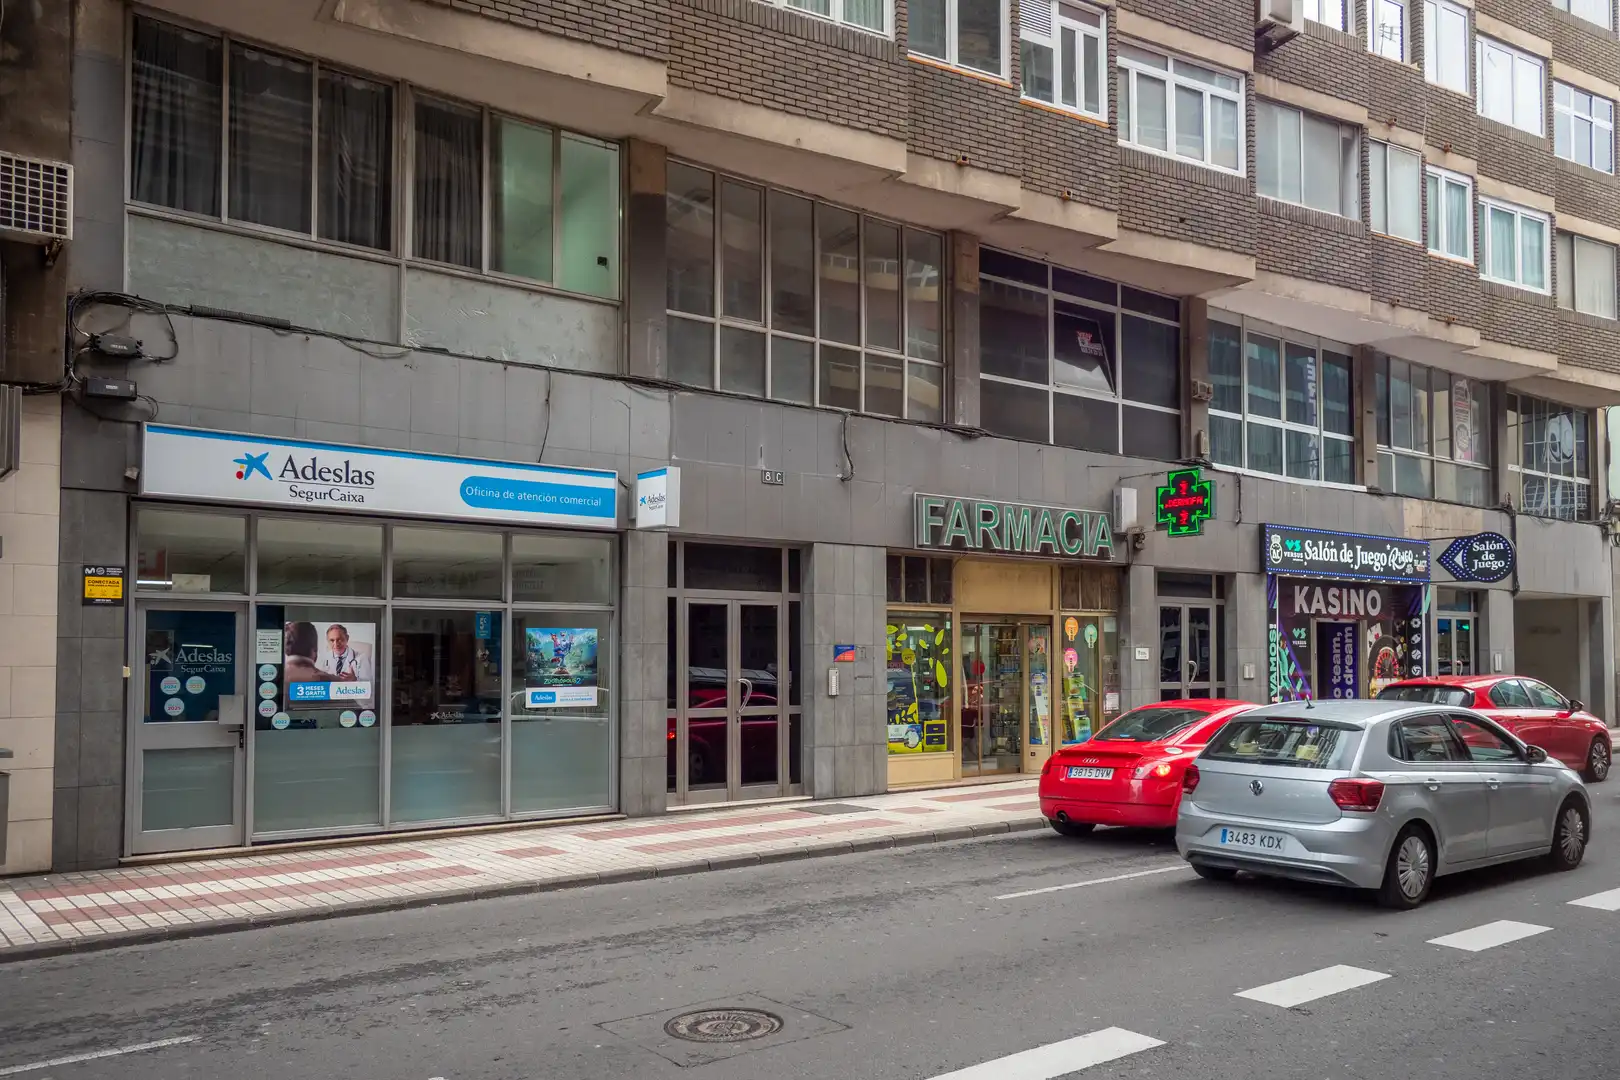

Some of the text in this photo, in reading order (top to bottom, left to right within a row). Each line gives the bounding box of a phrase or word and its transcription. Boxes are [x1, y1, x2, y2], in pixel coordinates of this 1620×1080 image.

[279, 454, 375, 486] Adeslas
[776, 472, 782, 482] C
[289, 484, 365, 503] SegurCaixa
[465, 486, 602, 506] Oficina de atención comercial
[648, 493, 666, 503] Adeslas
[921, 497, 1116, 558] FARMACIA
[1472, 540, 1504, 552] Salón
[1304, 540, 1338, 562] Salón
[1340, 542, 1354, 563] de
[1354, 545, 1388, 572] Juego
[1481, 551, 1495, 560] de
[1471, 559, 1505, 572] Juego
[1294, 585, 1382, 617] KASINO
[175, 647, 233, 663] Adeslas
[1343, 626, 1354, 685] dream
[180, 664, 226, 674] SegurCaixa
[296, 686, 304, 696] 3
[335, 686, 366, 695] Adeslas
[1073, 767, 1112, 778] 3815 DVM
[1227, 830, 1283, 849] 3483 KDX
